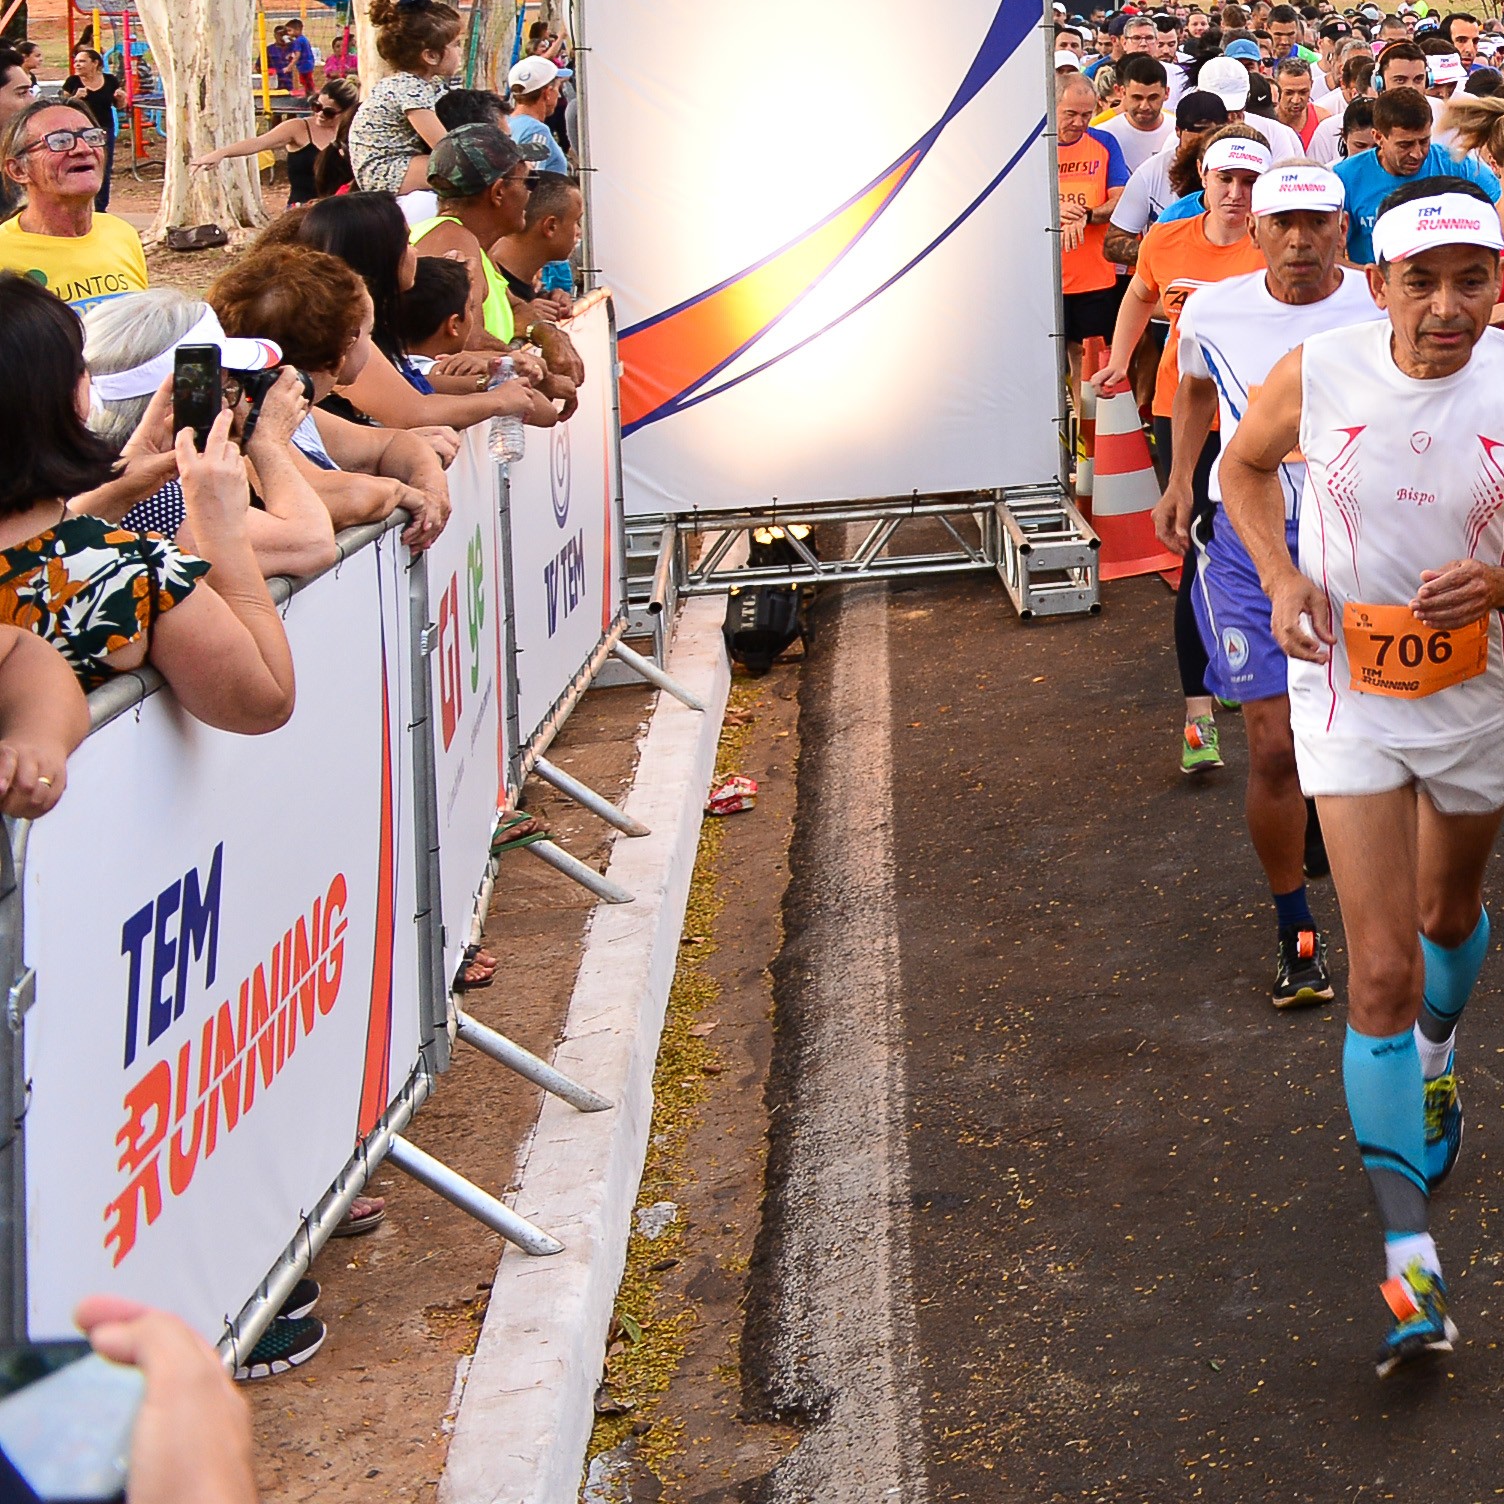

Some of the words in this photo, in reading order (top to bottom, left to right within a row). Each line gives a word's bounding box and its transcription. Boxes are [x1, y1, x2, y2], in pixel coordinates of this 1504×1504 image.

[1417, 206, 1443, 219] TEM
[1415, 218, 1481, 231] RUNNING
[1396, 486, 1436, 506] Bispo
[560, 527, 586, 620] TEM
[1369, 630, 1453, 668] 706
[1361, 666, 1383, 679] TEM
[1361, 675, 1421, 692] RUNNING
[120, 840, 224, 1070] TEM
[103, 871, 349, 1269] RUNNING
